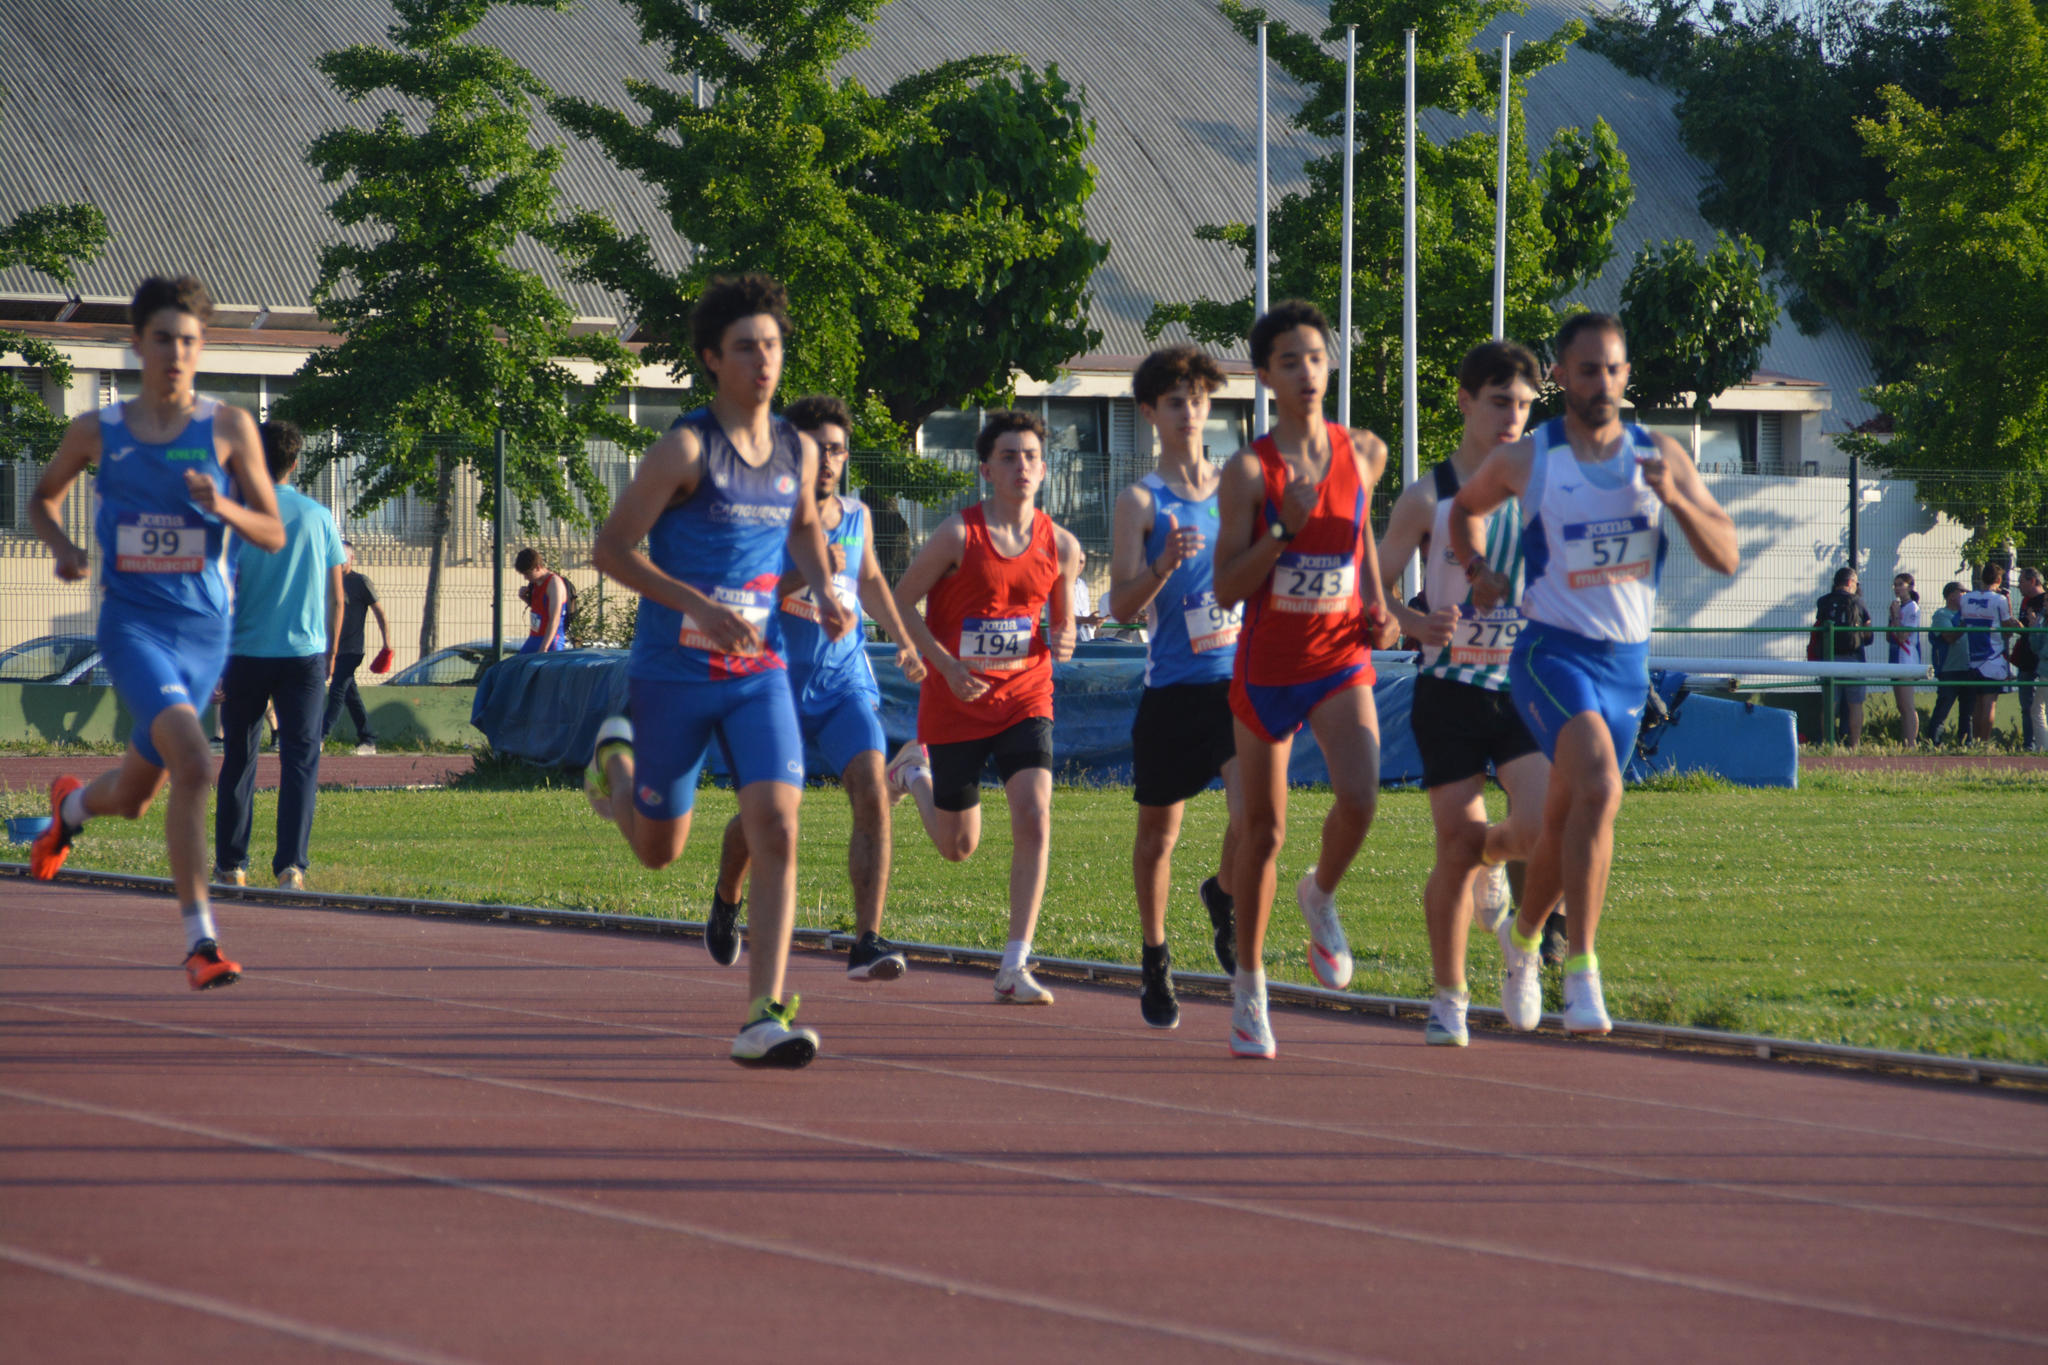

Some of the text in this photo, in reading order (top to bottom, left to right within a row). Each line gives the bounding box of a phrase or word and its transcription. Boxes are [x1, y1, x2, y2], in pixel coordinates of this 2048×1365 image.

[142, 529, 180, 556] 99
[1593, 537, 1629, 567] 57
[123, 558, 198, 572] mutuacat
[1288, 571, 1342, 597] 243
[1473, 608, 1519, 621] Jma
[973, 633, 1019, 656] 194
[1468, 623, 1521, 647] 279
